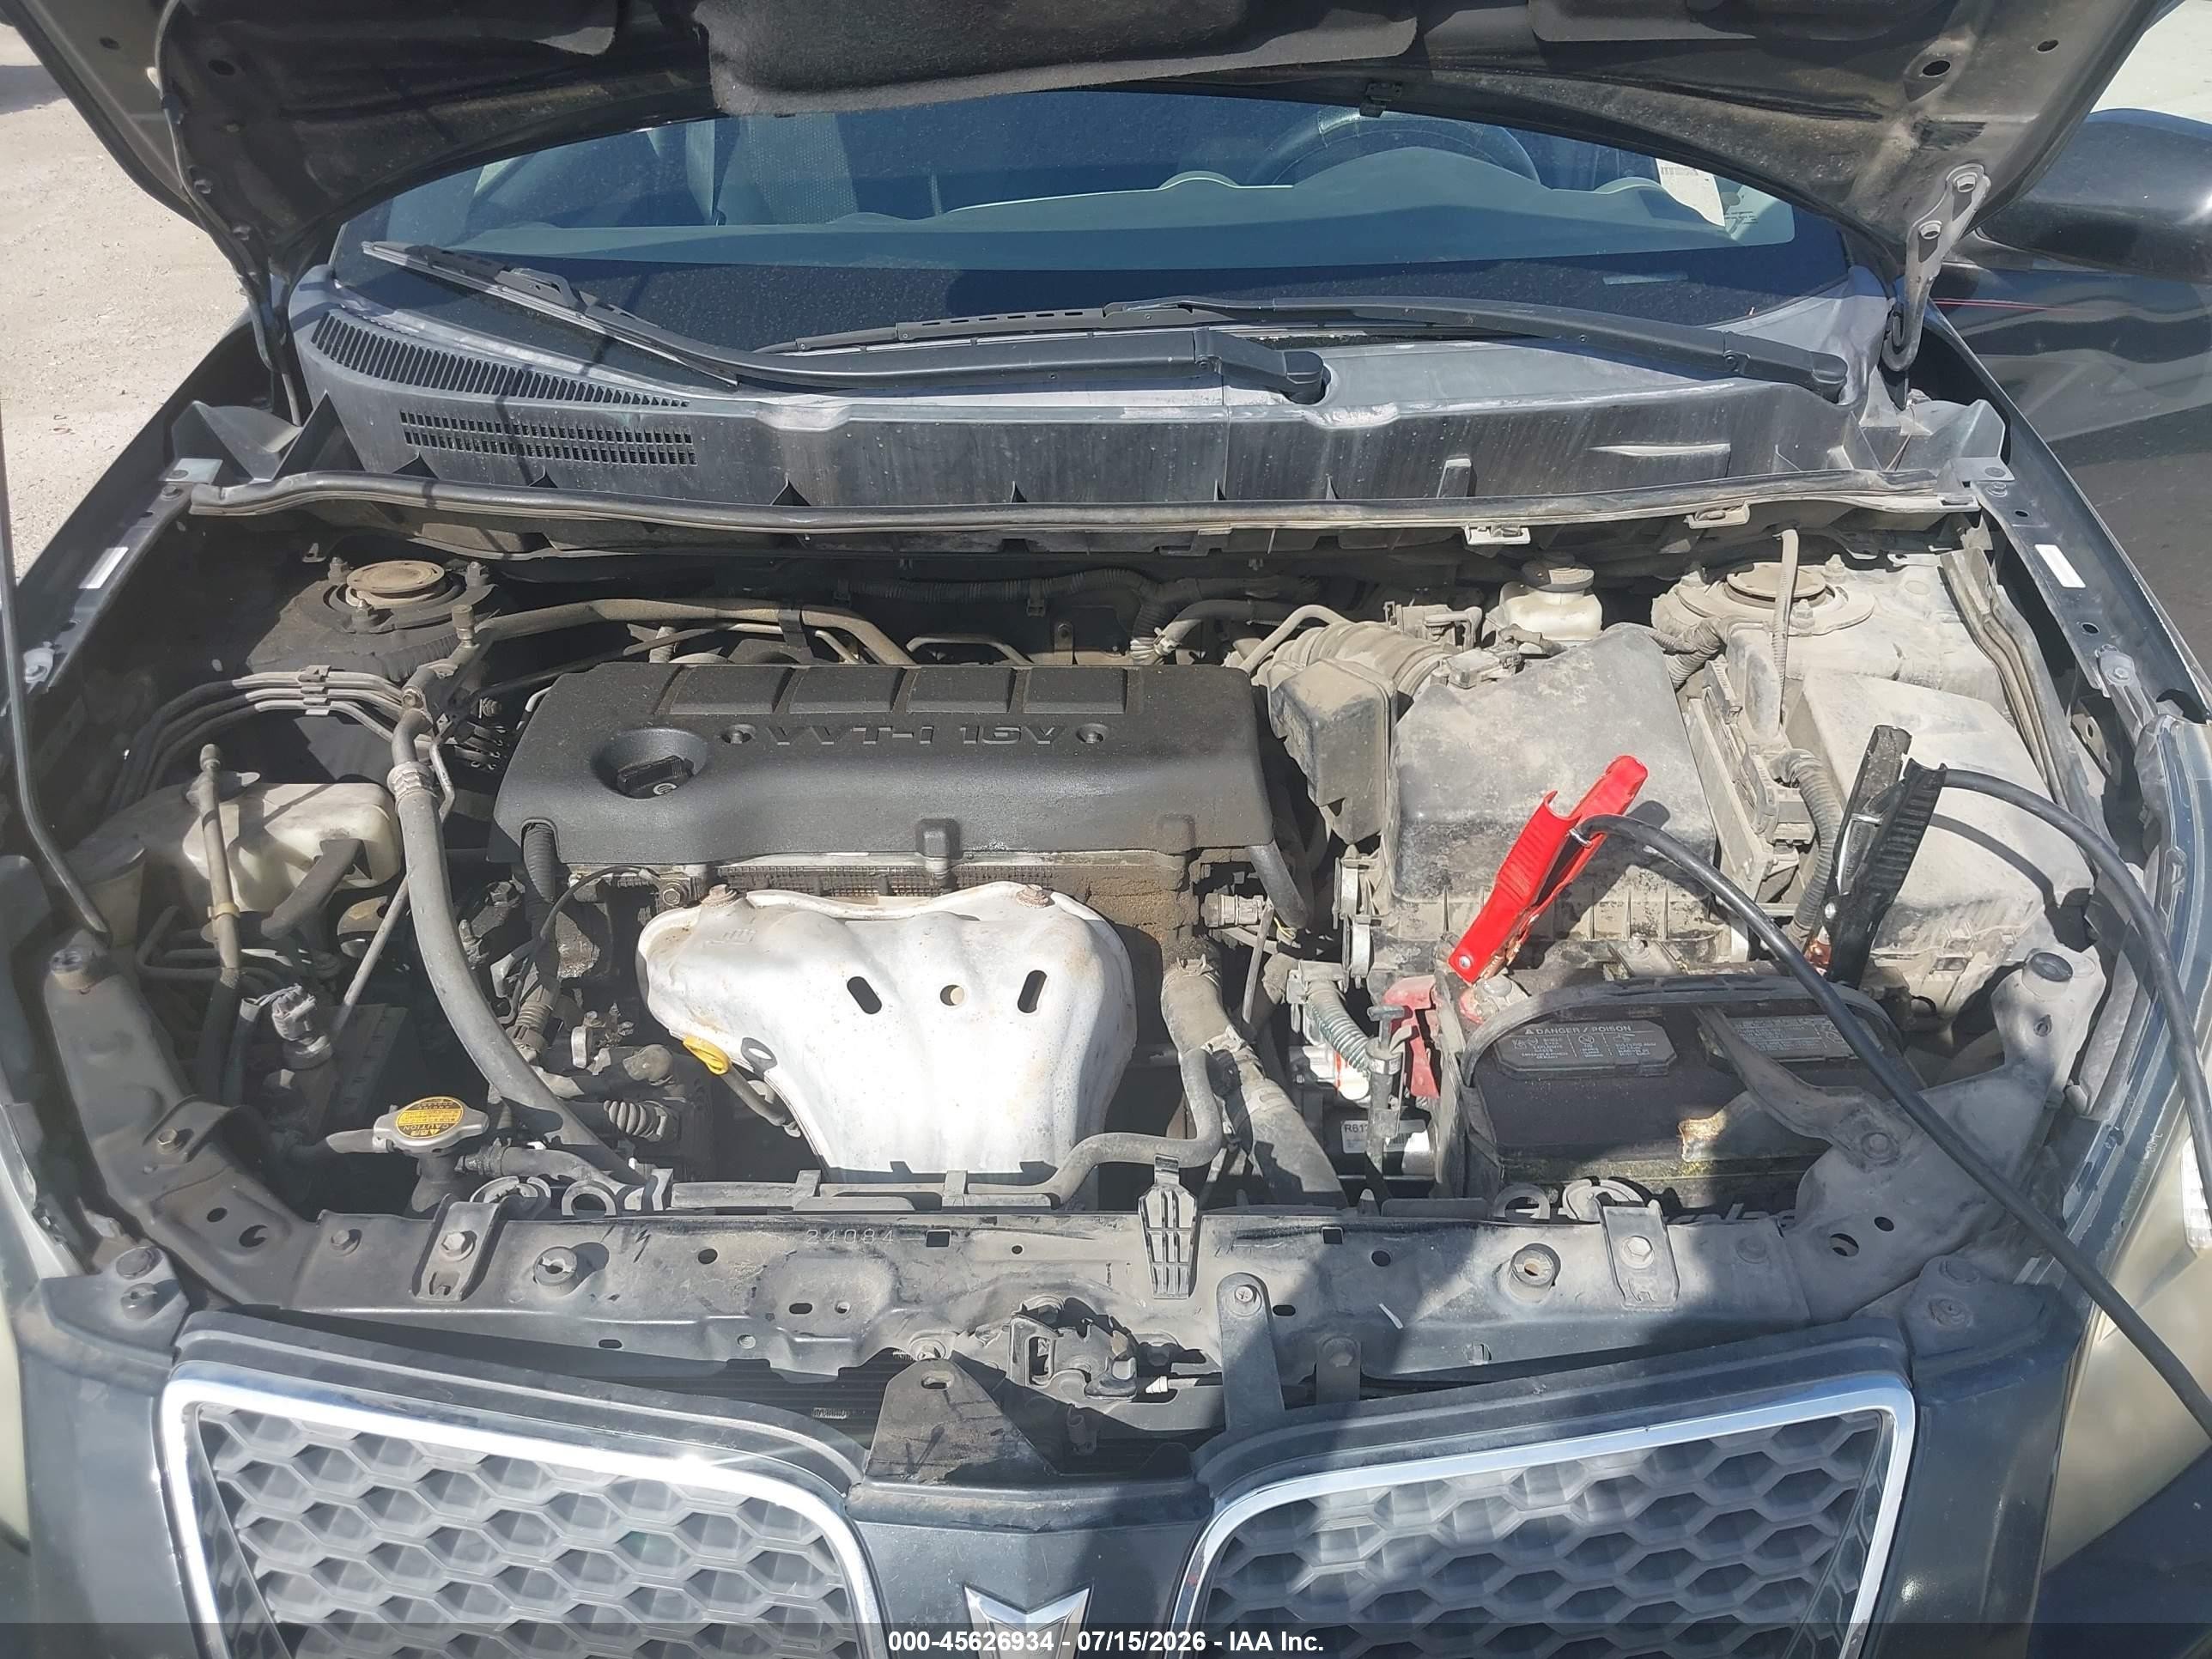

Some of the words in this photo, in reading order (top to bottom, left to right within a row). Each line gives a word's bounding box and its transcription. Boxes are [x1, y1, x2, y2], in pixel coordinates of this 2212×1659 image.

[959, 723, 1066, 744] 16V
[403, 1123, 450, 1132] CAUTION
[806, 1228, 894, 1244] 24084
